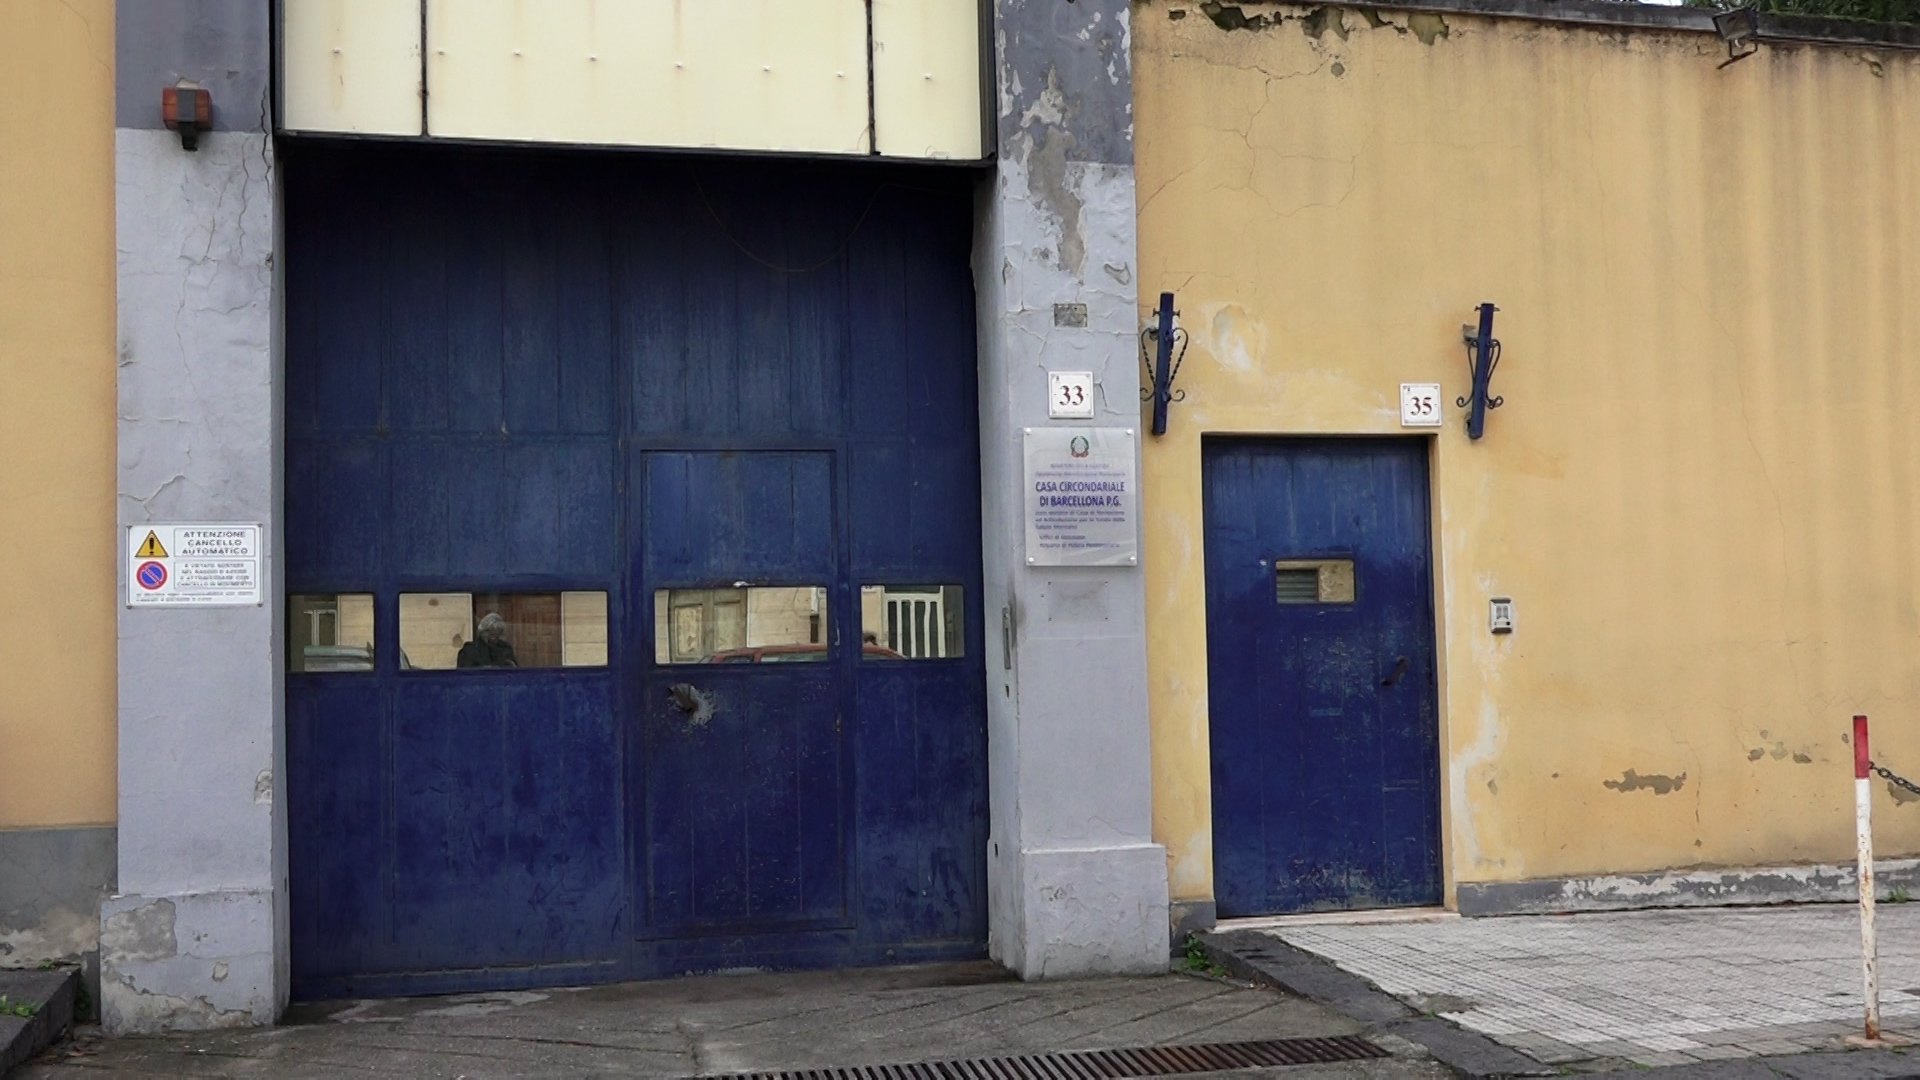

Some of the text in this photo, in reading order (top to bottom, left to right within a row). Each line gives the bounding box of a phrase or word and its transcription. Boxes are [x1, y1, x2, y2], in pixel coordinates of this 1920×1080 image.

[1059, 385, 1084, 406] 33
[1410, 396, 1432, 416] 35
[1035, 481, 1125, 492] CASA CIRCONDARIALE
[1039, 495, 1049, 507] DI
[1050, 495, 1105, 507] BARCELLONA
[187, 539, 242, 547] CANCELLO
